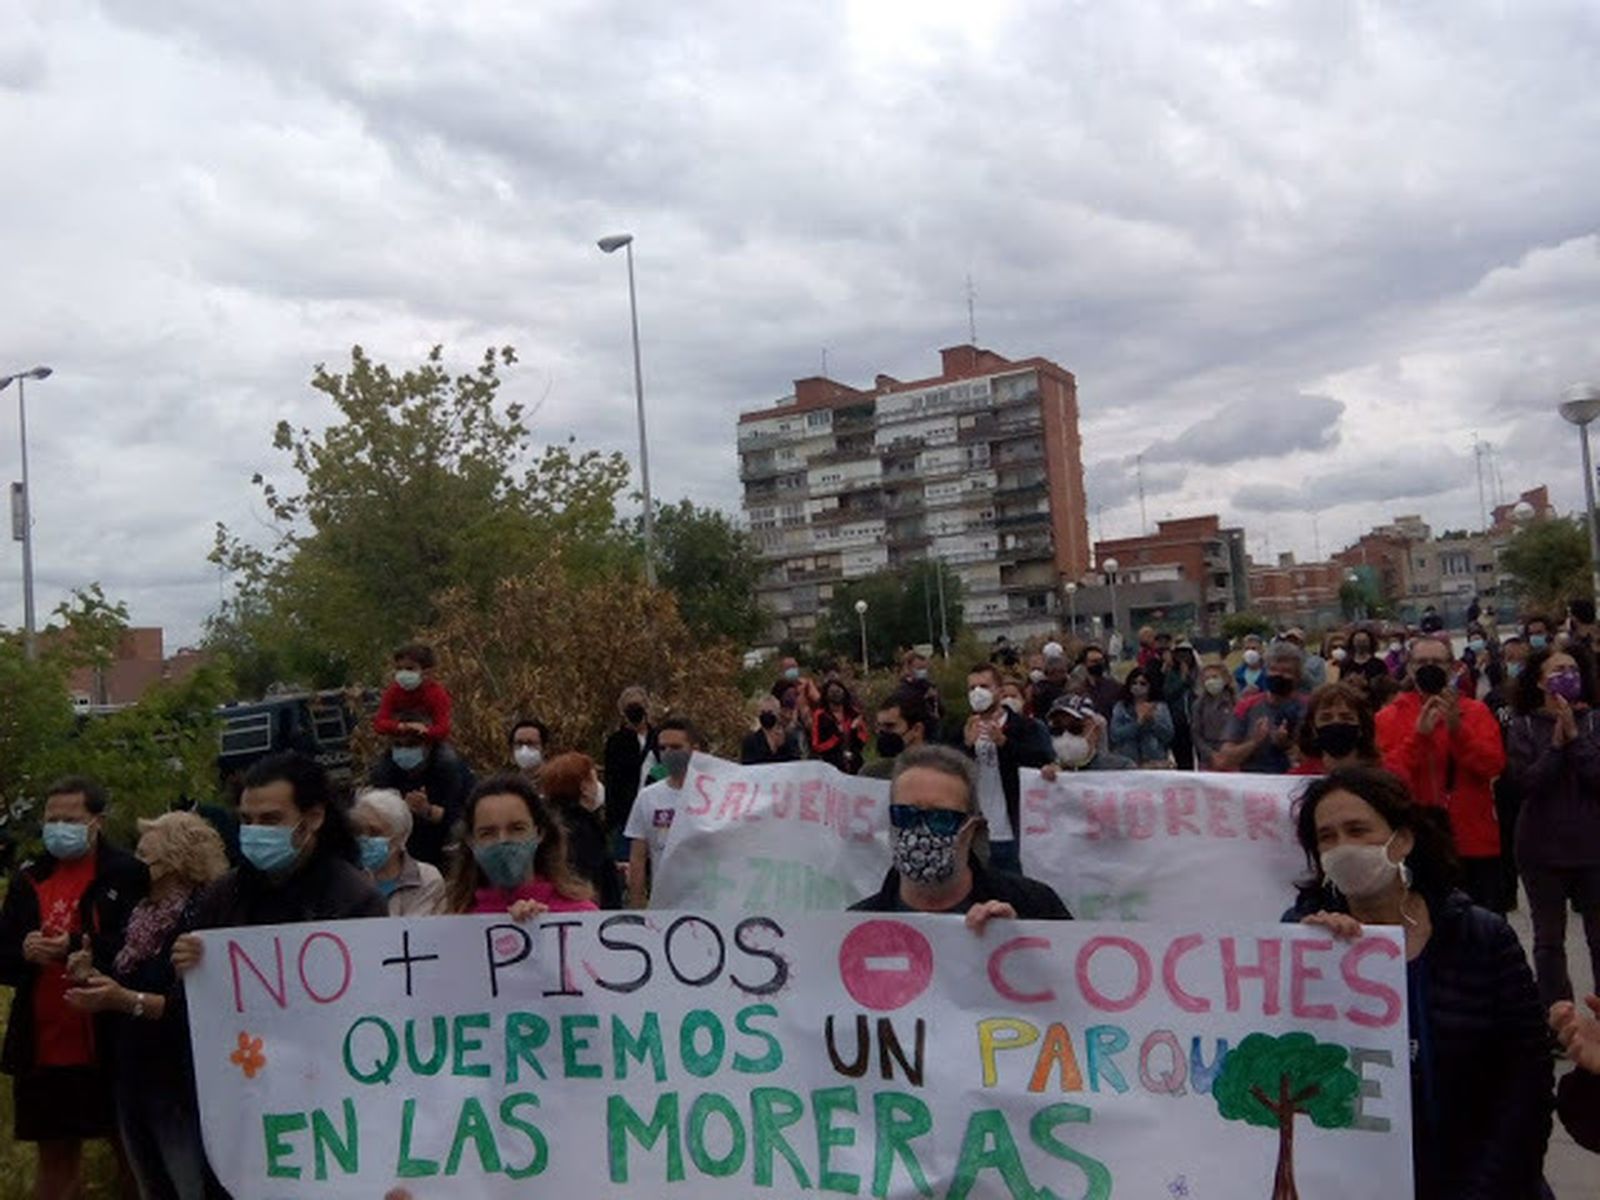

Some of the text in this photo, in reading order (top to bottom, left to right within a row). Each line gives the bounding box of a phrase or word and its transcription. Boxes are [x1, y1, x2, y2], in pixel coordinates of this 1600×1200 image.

[1082, 786, 1298, 841] MORER
[227, 914, 1402, 1029] NO + PISOS COCHES
[342, 1003, 784, 1085] QUEREMOS
[825, 1014, 926, 1087] UN
[262, 1086, 1113, 1200] EN LAS MORERAS
